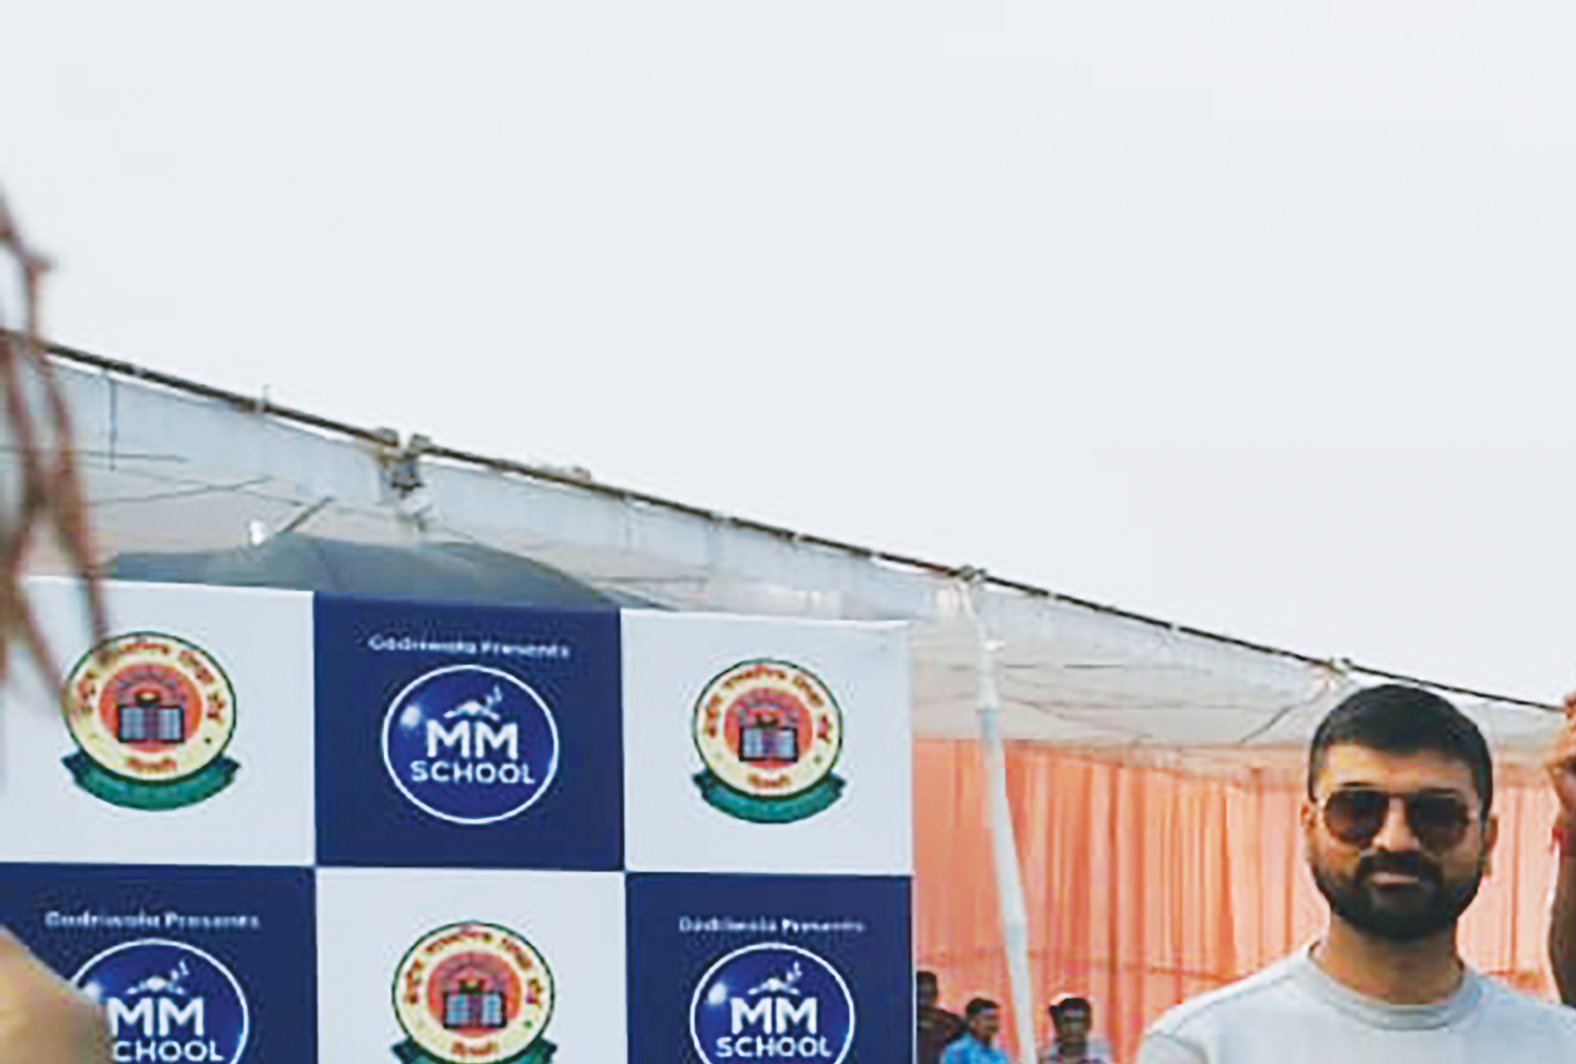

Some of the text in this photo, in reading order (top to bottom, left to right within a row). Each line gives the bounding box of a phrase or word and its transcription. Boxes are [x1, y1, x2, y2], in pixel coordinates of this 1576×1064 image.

[426, 719, 518, 760] MM
[410, 761, 535, 784] SCHOOL
[107, 997, 204, 1037] MM
[730, 997, 817, 1035] MM
[113, 1040, 226, 1063] CHOOL
[715, 1035, 833, 1058] SCHOOL
